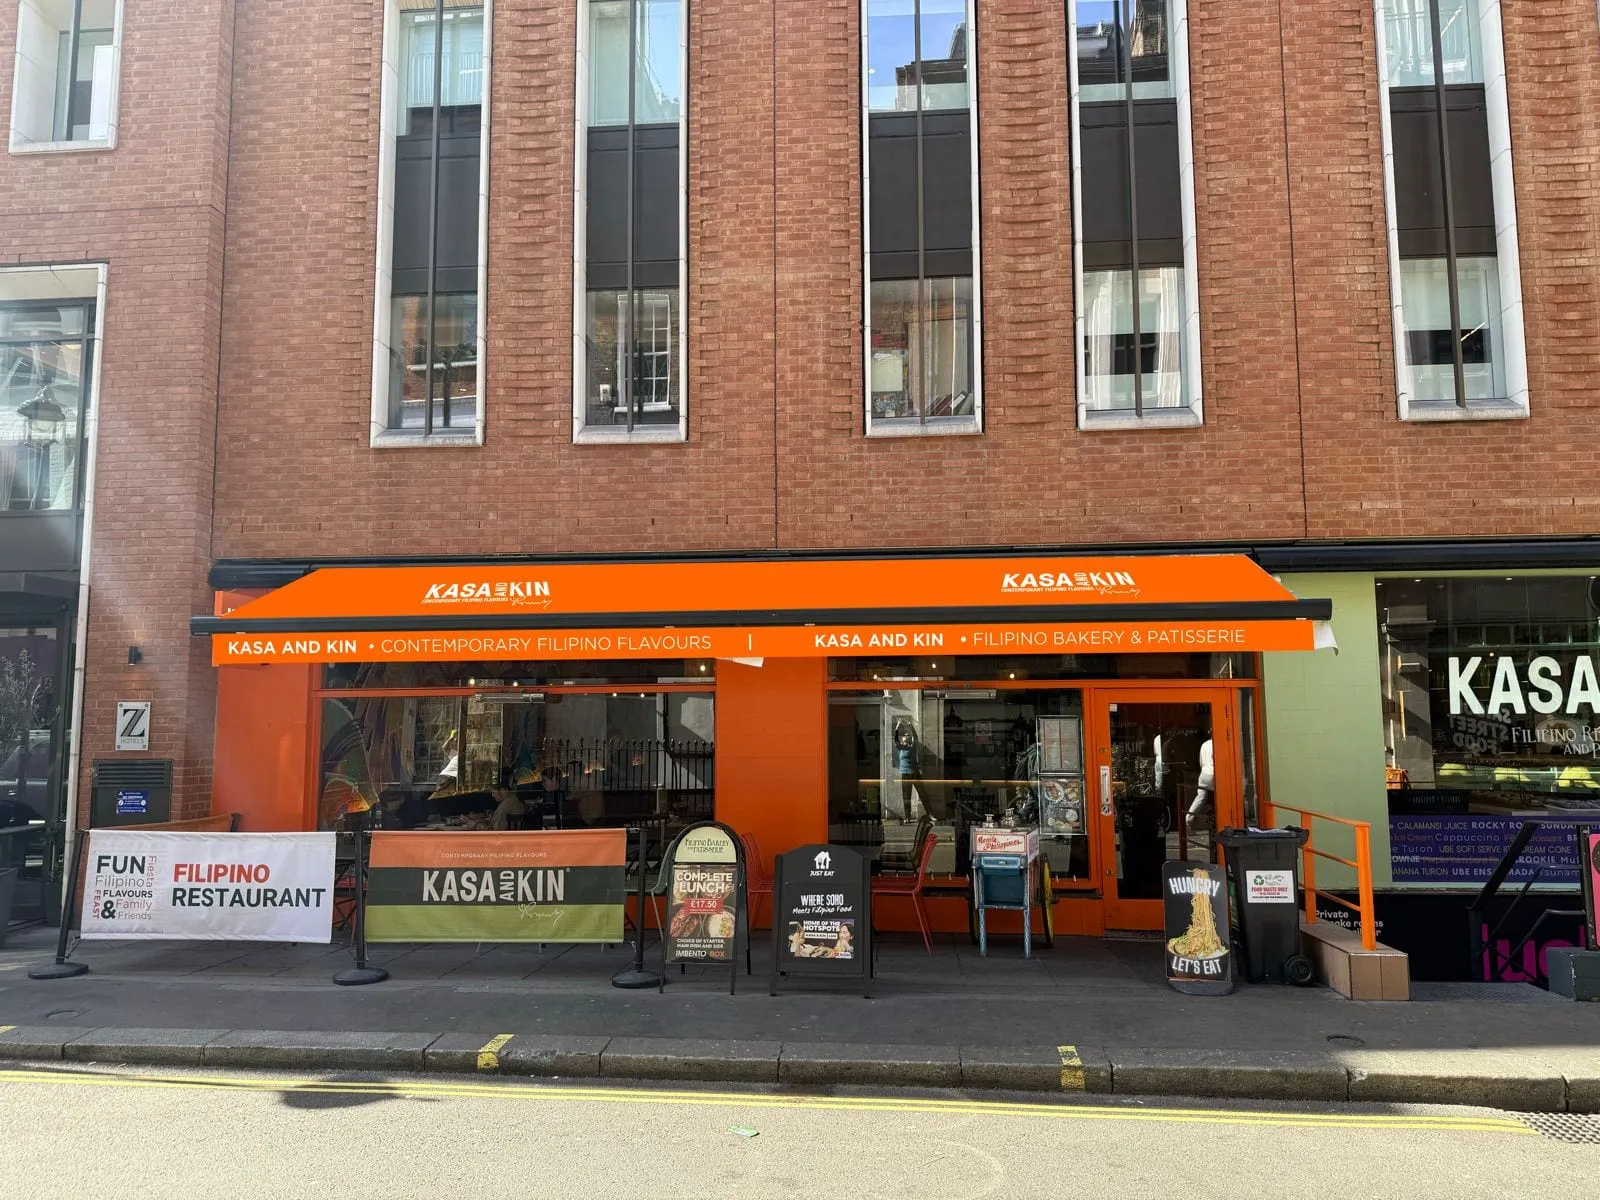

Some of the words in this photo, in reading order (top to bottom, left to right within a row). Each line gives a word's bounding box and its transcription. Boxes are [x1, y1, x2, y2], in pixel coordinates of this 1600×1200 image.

[1002, 573, 1074, 587] KASA
[1089, 572, 1136, 586] KIN
[424, 583, 491, 598] KASA
[510, 581, 550, 597] KIN
[228, 640, 276, 655] KASA
[282, 640, 320, 654] AND
[327, 640, 356, 654] KIN
[381, 638, 532, 653] CONTEMPORARY
[538, 636, 611, 651] FILIPINO
[618, 636, 712, 650] FLAVOURS
[815, 634, 862, 648] KASA
[869, 633, 908, 647] AND
[914, 632, 944, 646] KIN
[973, 632, 1048, 646] FILIPINO
[1054, 631, 1125, 645] BAKERY
[1130, 630, 1142, 644] &
[1148, 630, 1245, 644] PATISSERIE
[1448, 655, 1600, 715] KASA
[120, 708, 146, 737] Z
[1511, 727, 1576, 743] FILIPINO
[1564, 744, 1589, 755] AND
[1397, 822, 1442, 830] CALAMANSI
[1444, 822, 1468, 830] JUICE
[1436, 834, 1500, 842] Cappuccino
[1402, 845, 1433, 853] Turon
[96, 856, 146, 874] FUN
[147, 856, 157, 888] Fiesta
[1392, 868, 1420, 876] ANANA
[1452, 868, 1470, 876] UBE
[1474, 868, 1534, 876] ENSADA
[174, 864, 270, 884] FILIPINO
[676, 872, 733, 882] COMPLETE
[96, 875, 144, 889] Filipino
[422, 870, 496, 902] KASA
[500, 870, 514, 901] AND
[518, 870, 564, 901] KIN
[680, 882, 725, 893] LUNCH
[1169, 876, 1220, 896] HUNGRY
[103, 889, 152, 898] FLAVOURS
[172, 888, 326, 908] RESTAURANT
[800, 894, 824, 906] WHERE
[826, 894, 844, 906] SOHO
[92, 890, 100, 919] FEAST
[101, 900, 116, 920] &
[116, 898, 152, 912] Family
[690, 900, 717, 908] £17.50
[812, 906, 835, 915] Filipino
[118, 912, 152, 920] Friends
[676, 950, 706, 958] IMBENTO
[1172, 956, 1200, 974] LET'S
[1203, 958, 1222, 974] EAT
